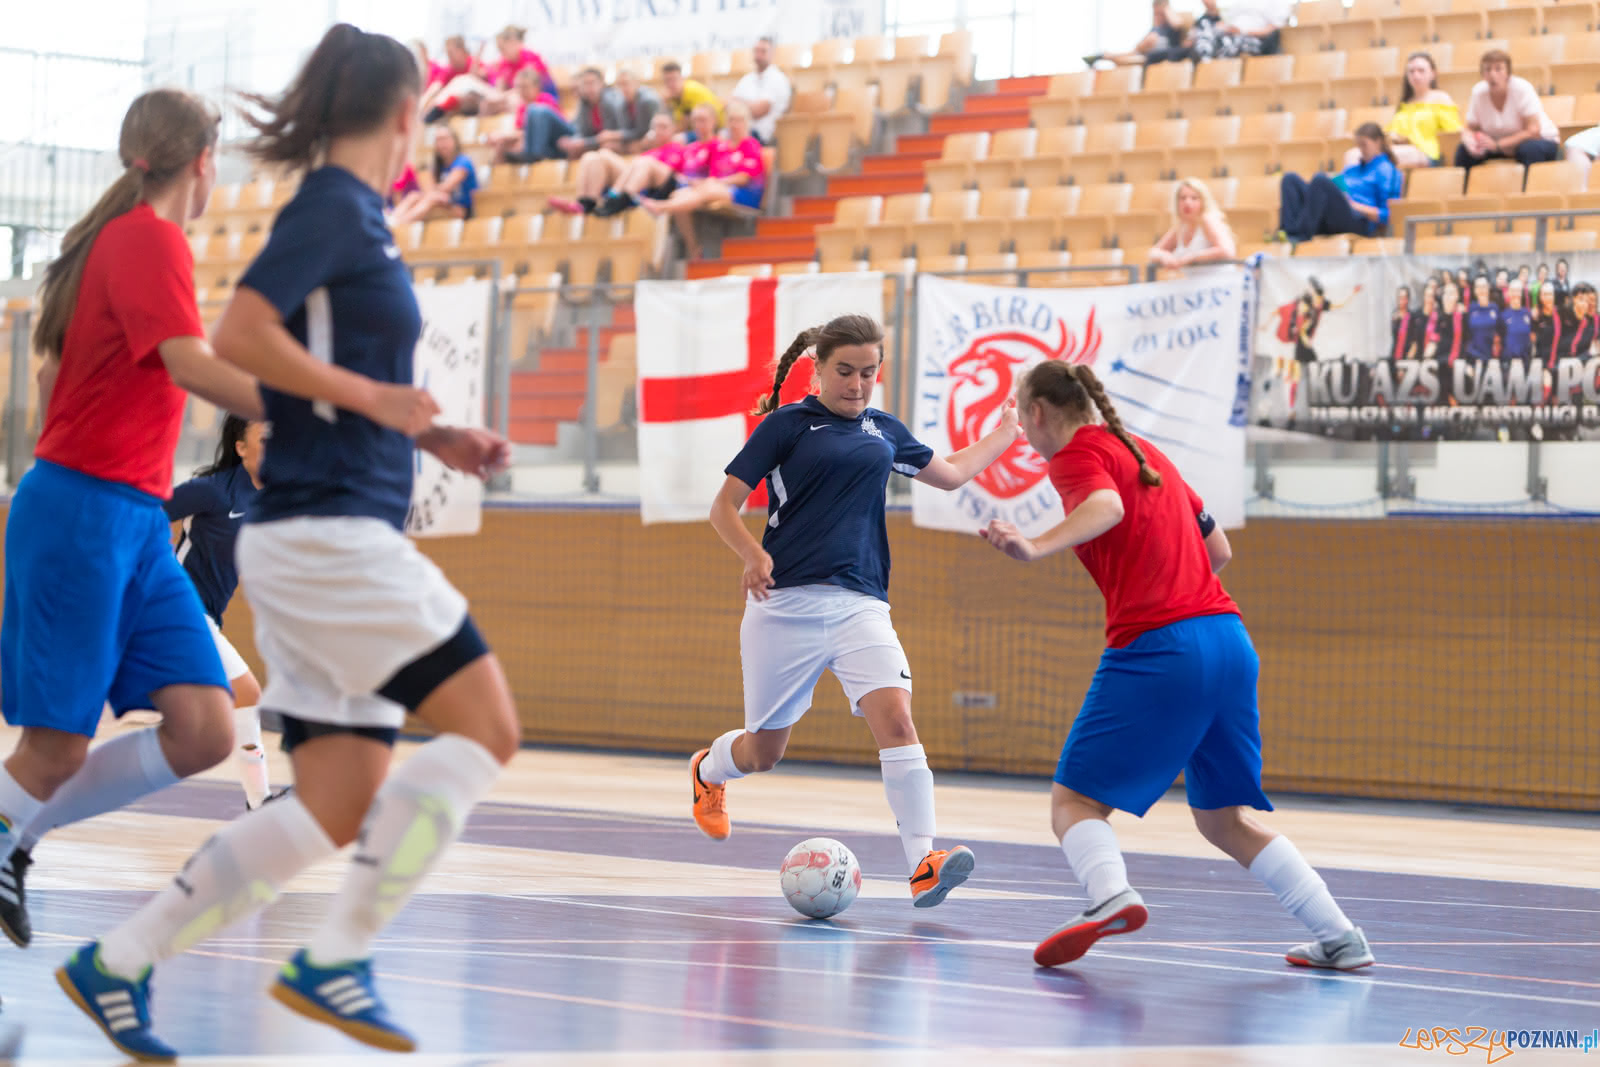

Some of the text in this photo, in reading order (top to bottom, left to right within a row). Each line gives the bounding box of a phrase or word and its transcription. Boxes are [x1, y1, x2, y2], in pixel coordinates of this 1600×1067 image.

[971, 296, 1053, 332] BIRD
[1369, 358, 1441, 403] AZS
[1453, 357, 1545, 403] UAM
[1013, 485, 1056, 528] CLU
